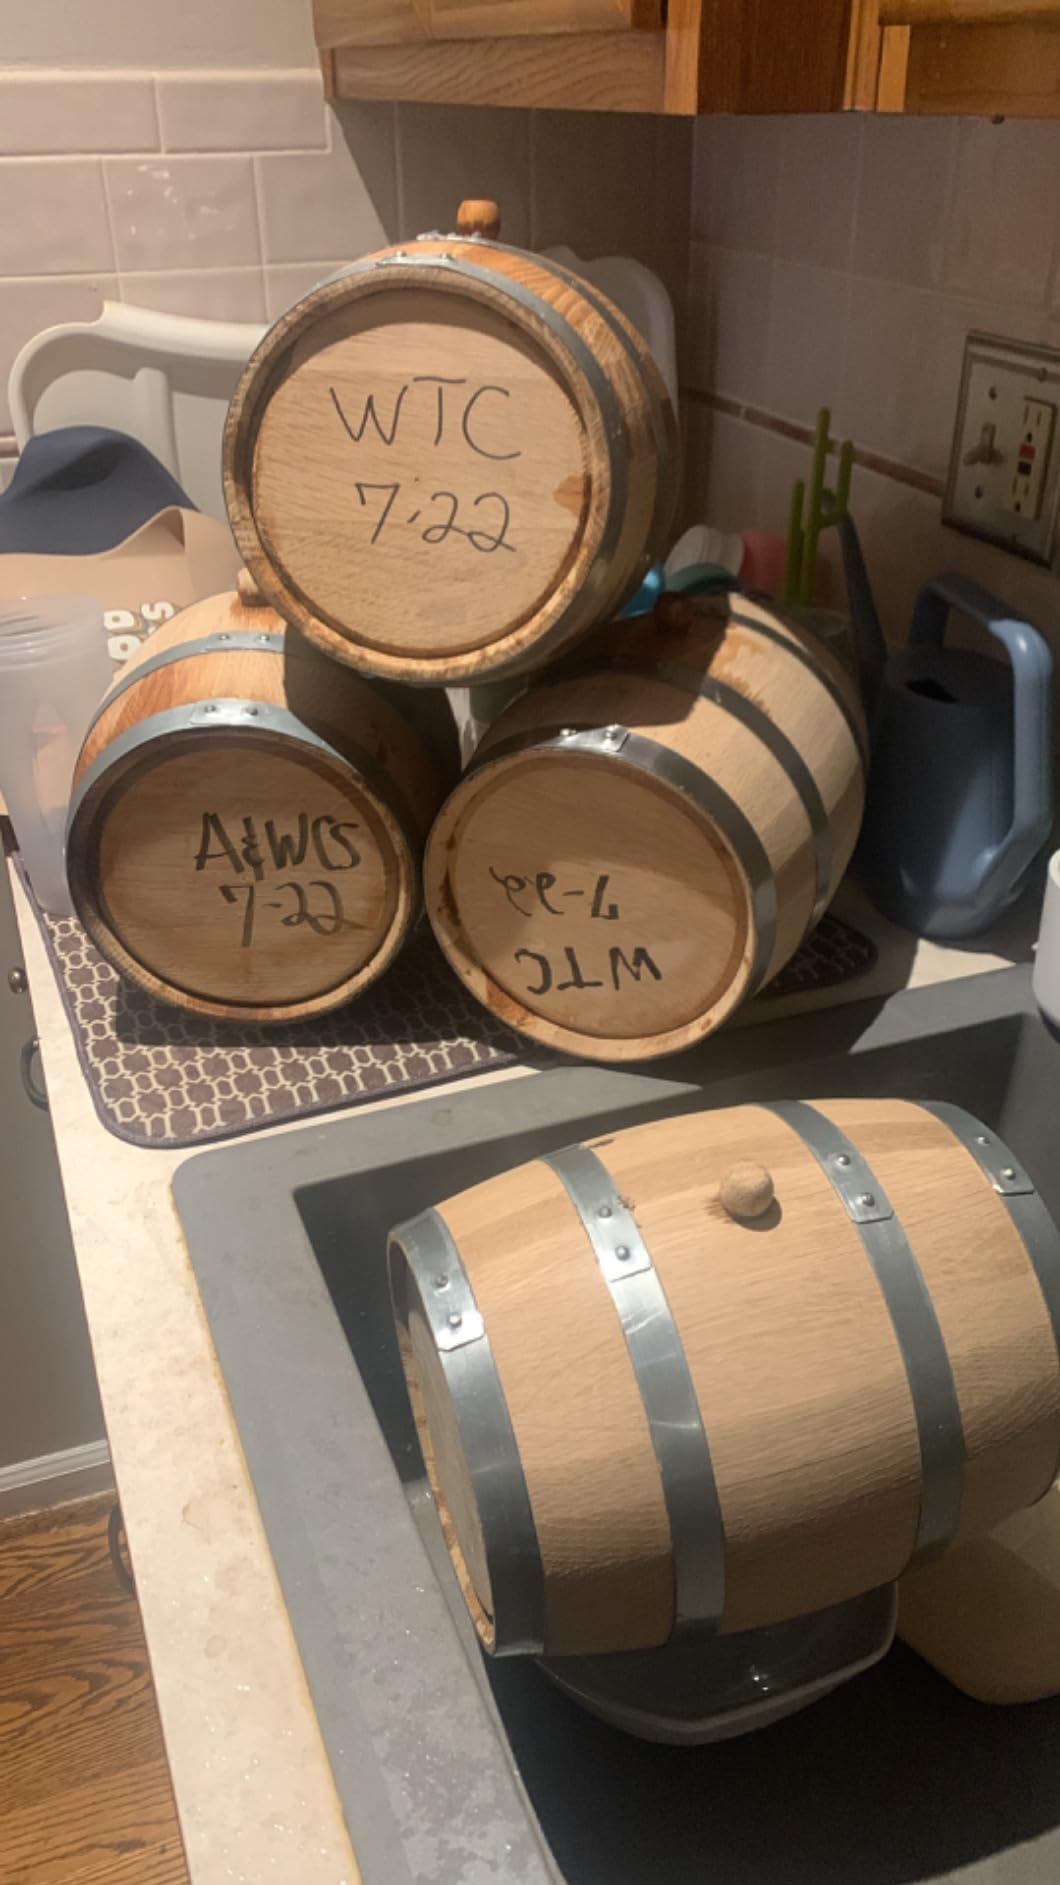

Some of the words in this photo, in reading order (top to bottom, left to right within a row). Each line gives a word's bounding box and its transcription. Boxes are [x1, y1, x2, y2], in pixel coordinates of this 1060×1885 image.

[330, 376, 521, 460] WTC
[219, 880, 370, 947] 7-22
[489, 867, 619, 920] 7-22
[514, 946, 662, 996] WTC
